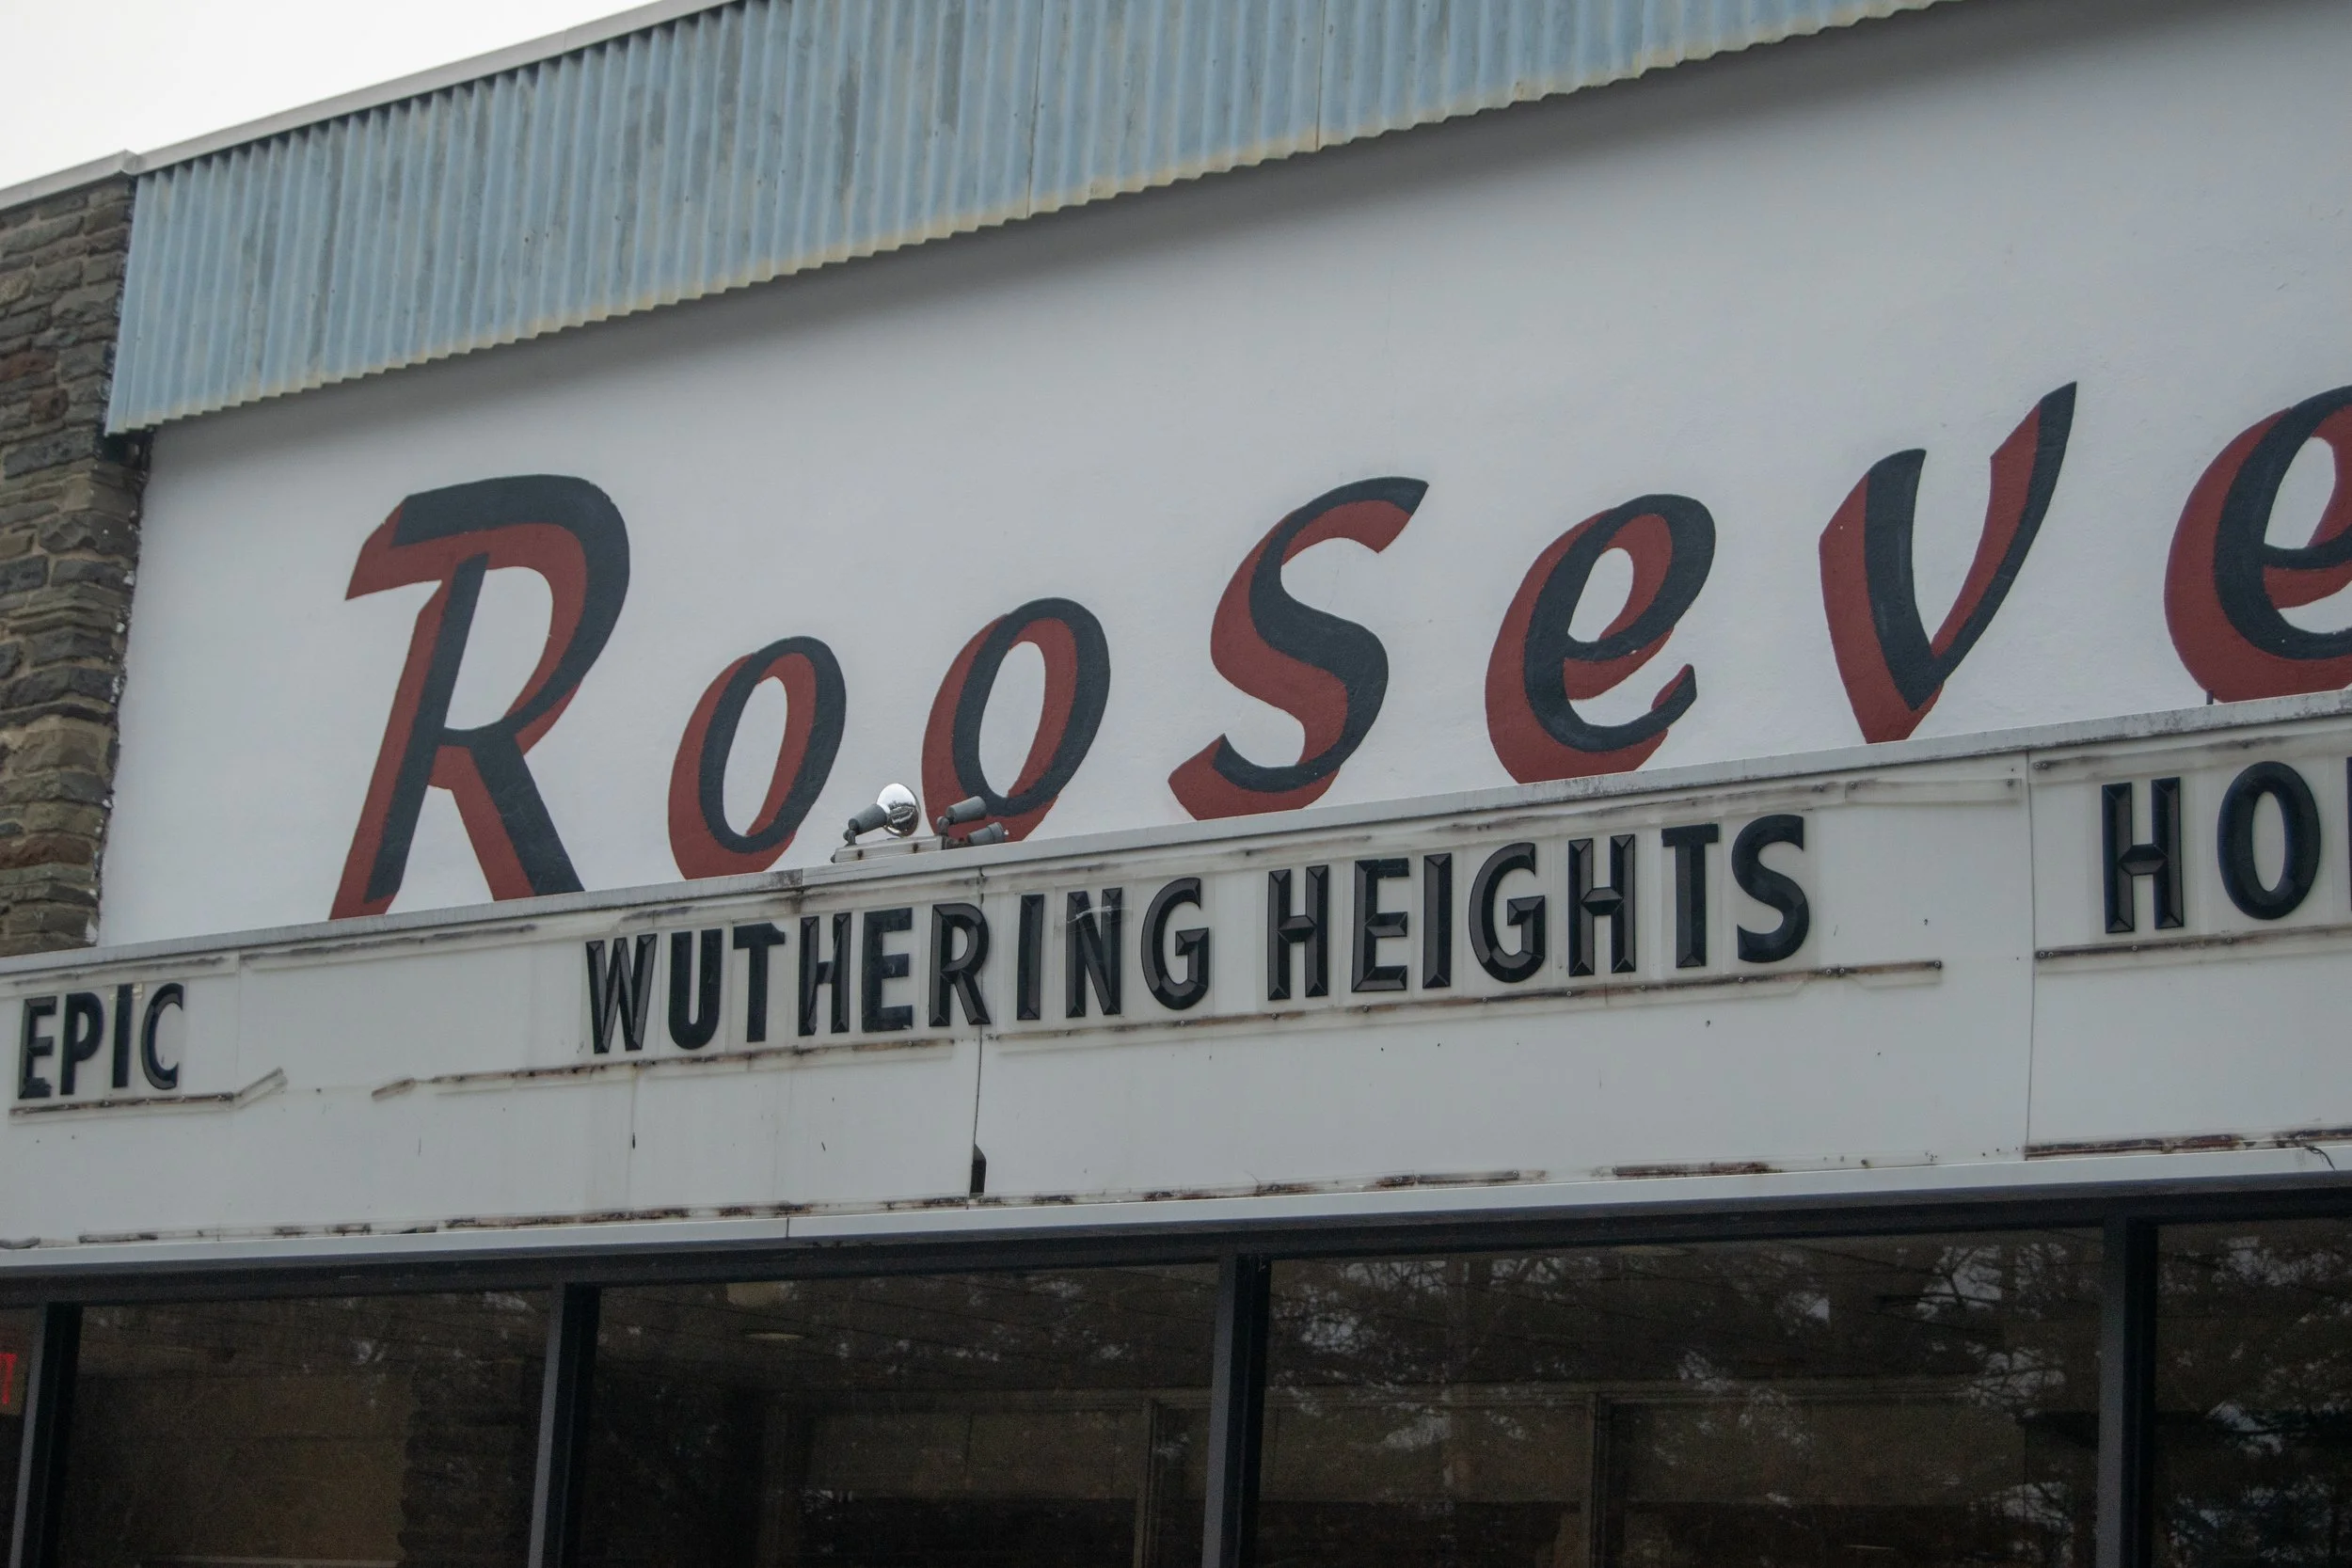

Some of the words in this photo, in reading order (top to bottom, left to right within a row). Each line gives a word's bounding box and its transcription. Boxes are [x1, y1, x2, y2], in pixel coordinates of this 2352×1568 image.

[329, 380, 2352, 919] Rooseve
[585, 876, 1210, 1054] WUTHERING
[1266, 814, 1810, 1001] HEIGHTS
[2102, 755, 2352, 934] HO
[18, 982, 184, 1100] EPIC
